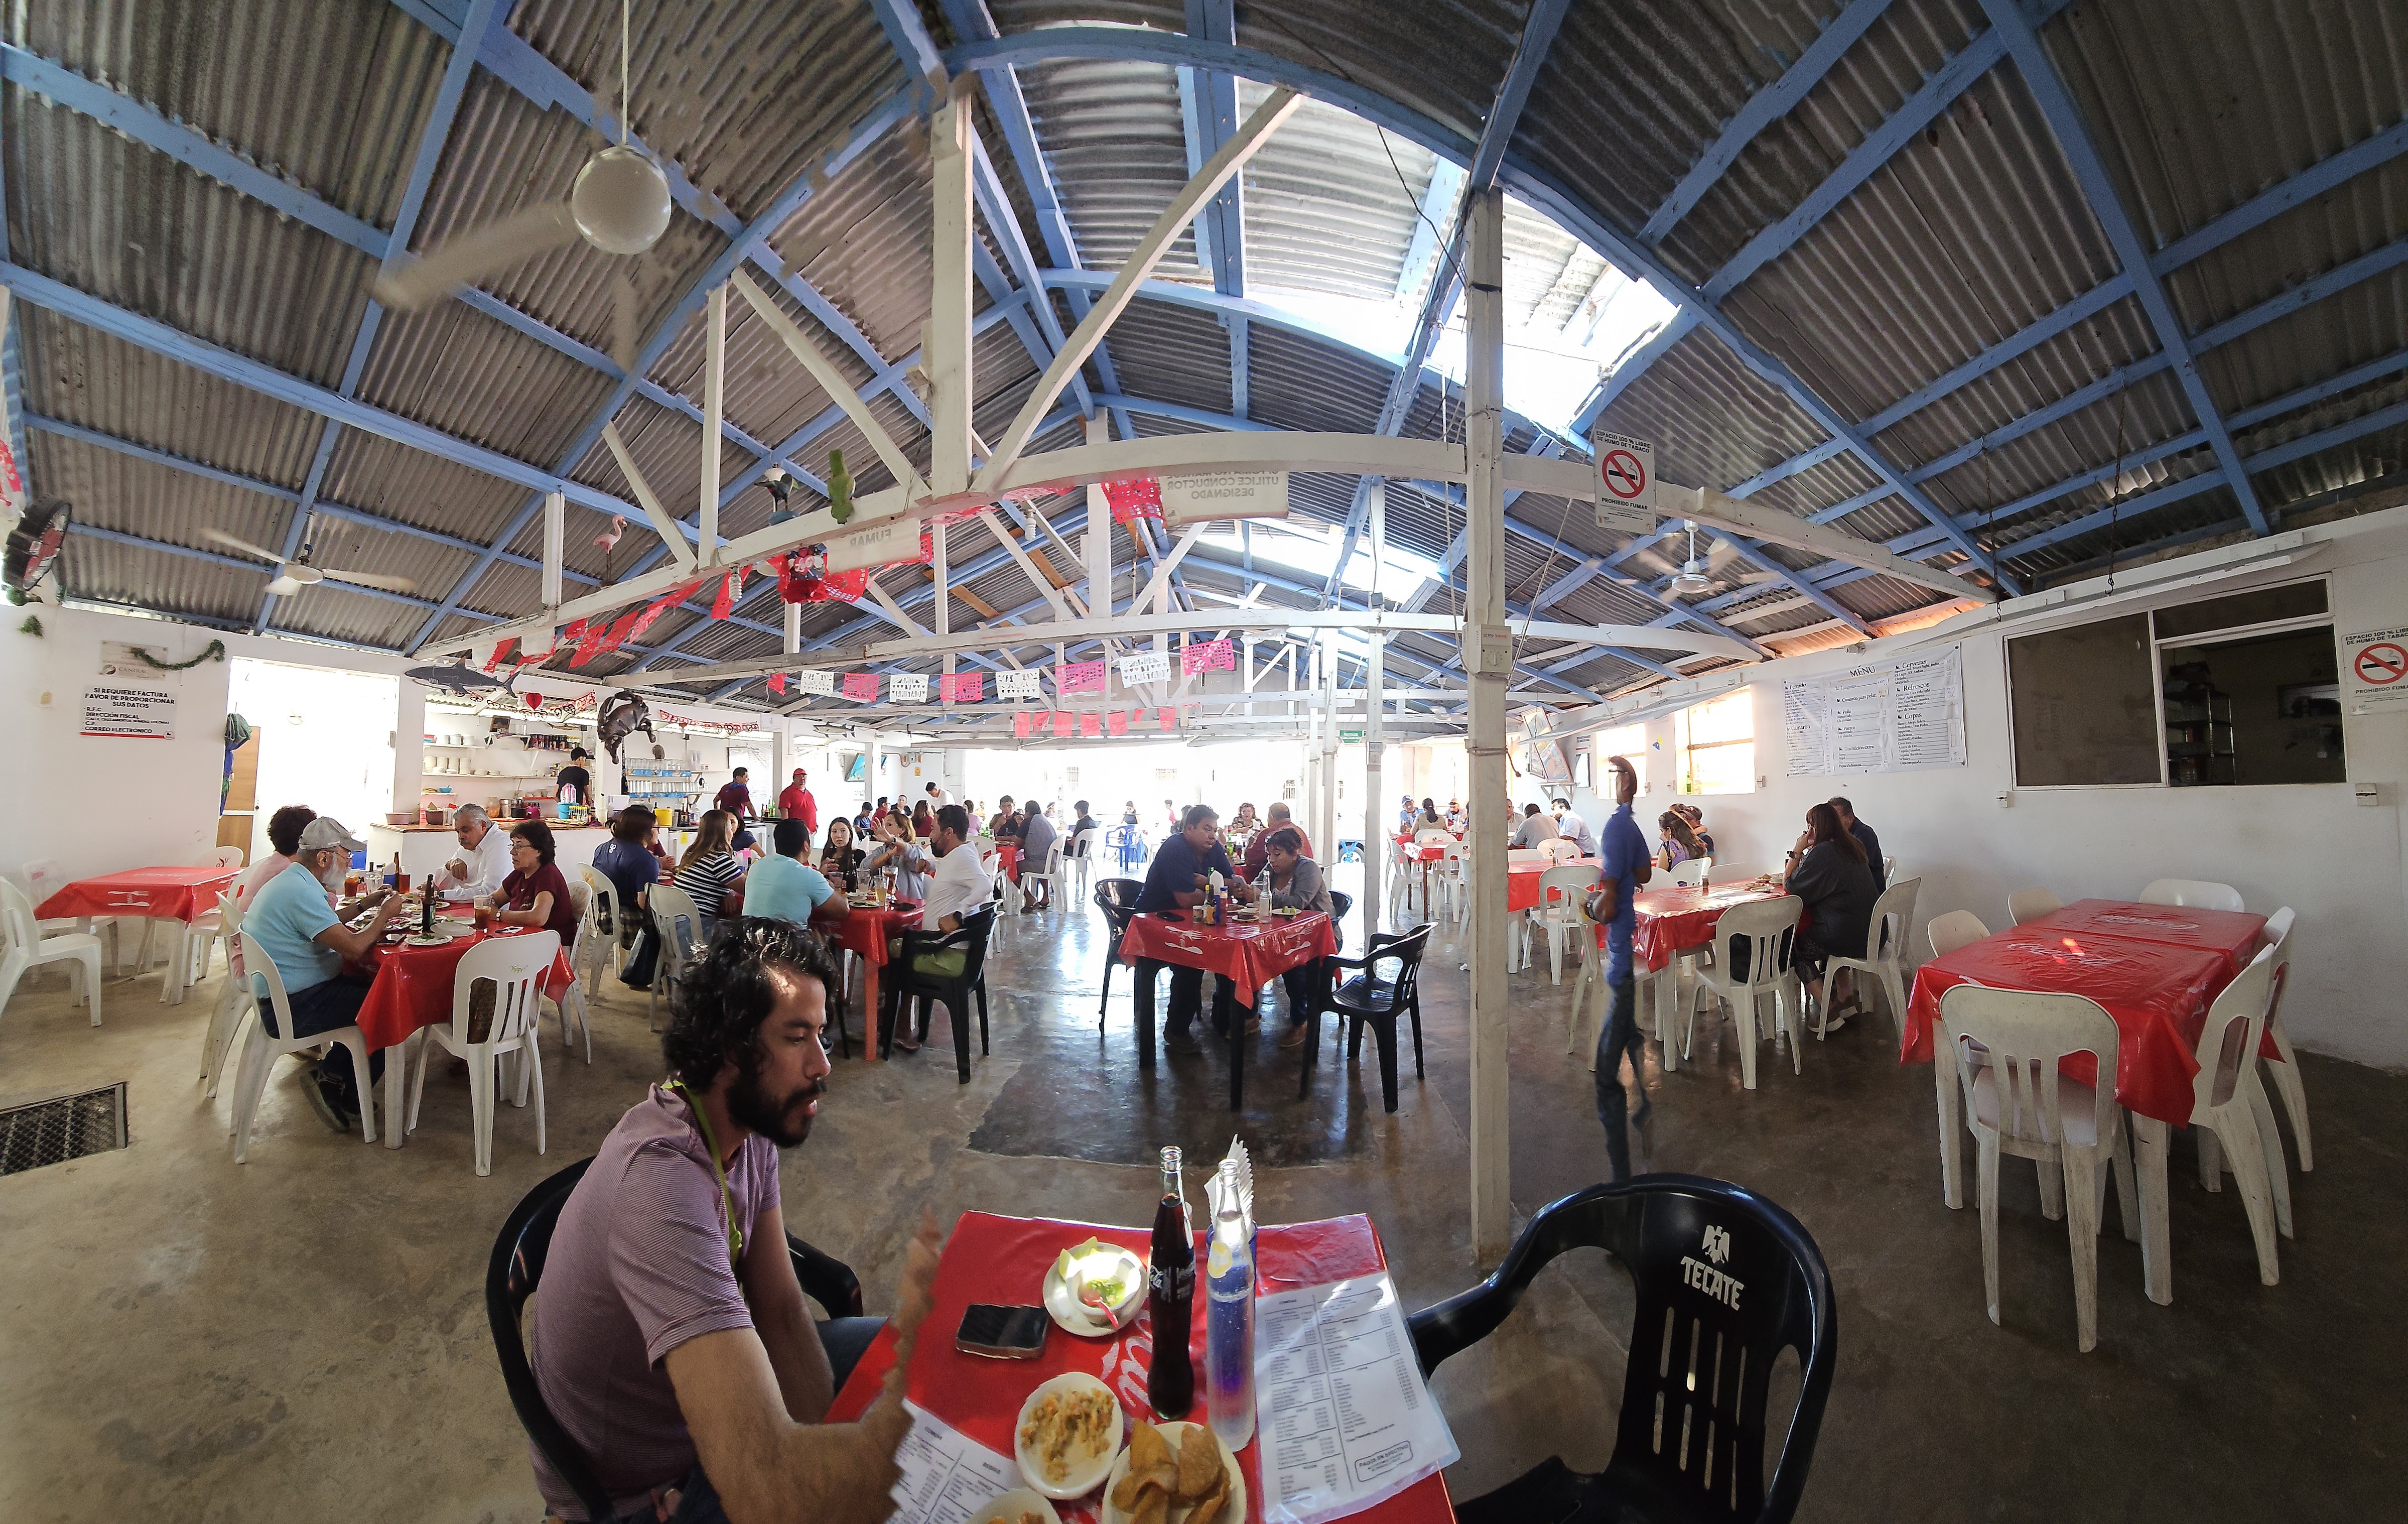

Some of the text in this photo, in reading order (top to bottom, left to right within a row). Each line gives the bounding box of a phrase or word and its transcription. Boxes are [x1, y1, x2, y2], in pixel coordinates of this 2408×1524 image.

[1596, 431, 1618, 440] ESPACIO
[1629, 444, 1649, 453] TABACO
[1601, 497, 1629, 506] PROHIBIDO
[1902, 660, 1927, 668] Cervezas
[1947, 687, 1955, 698] 32
[1680, 1256, 1745, 1311] TECATE
